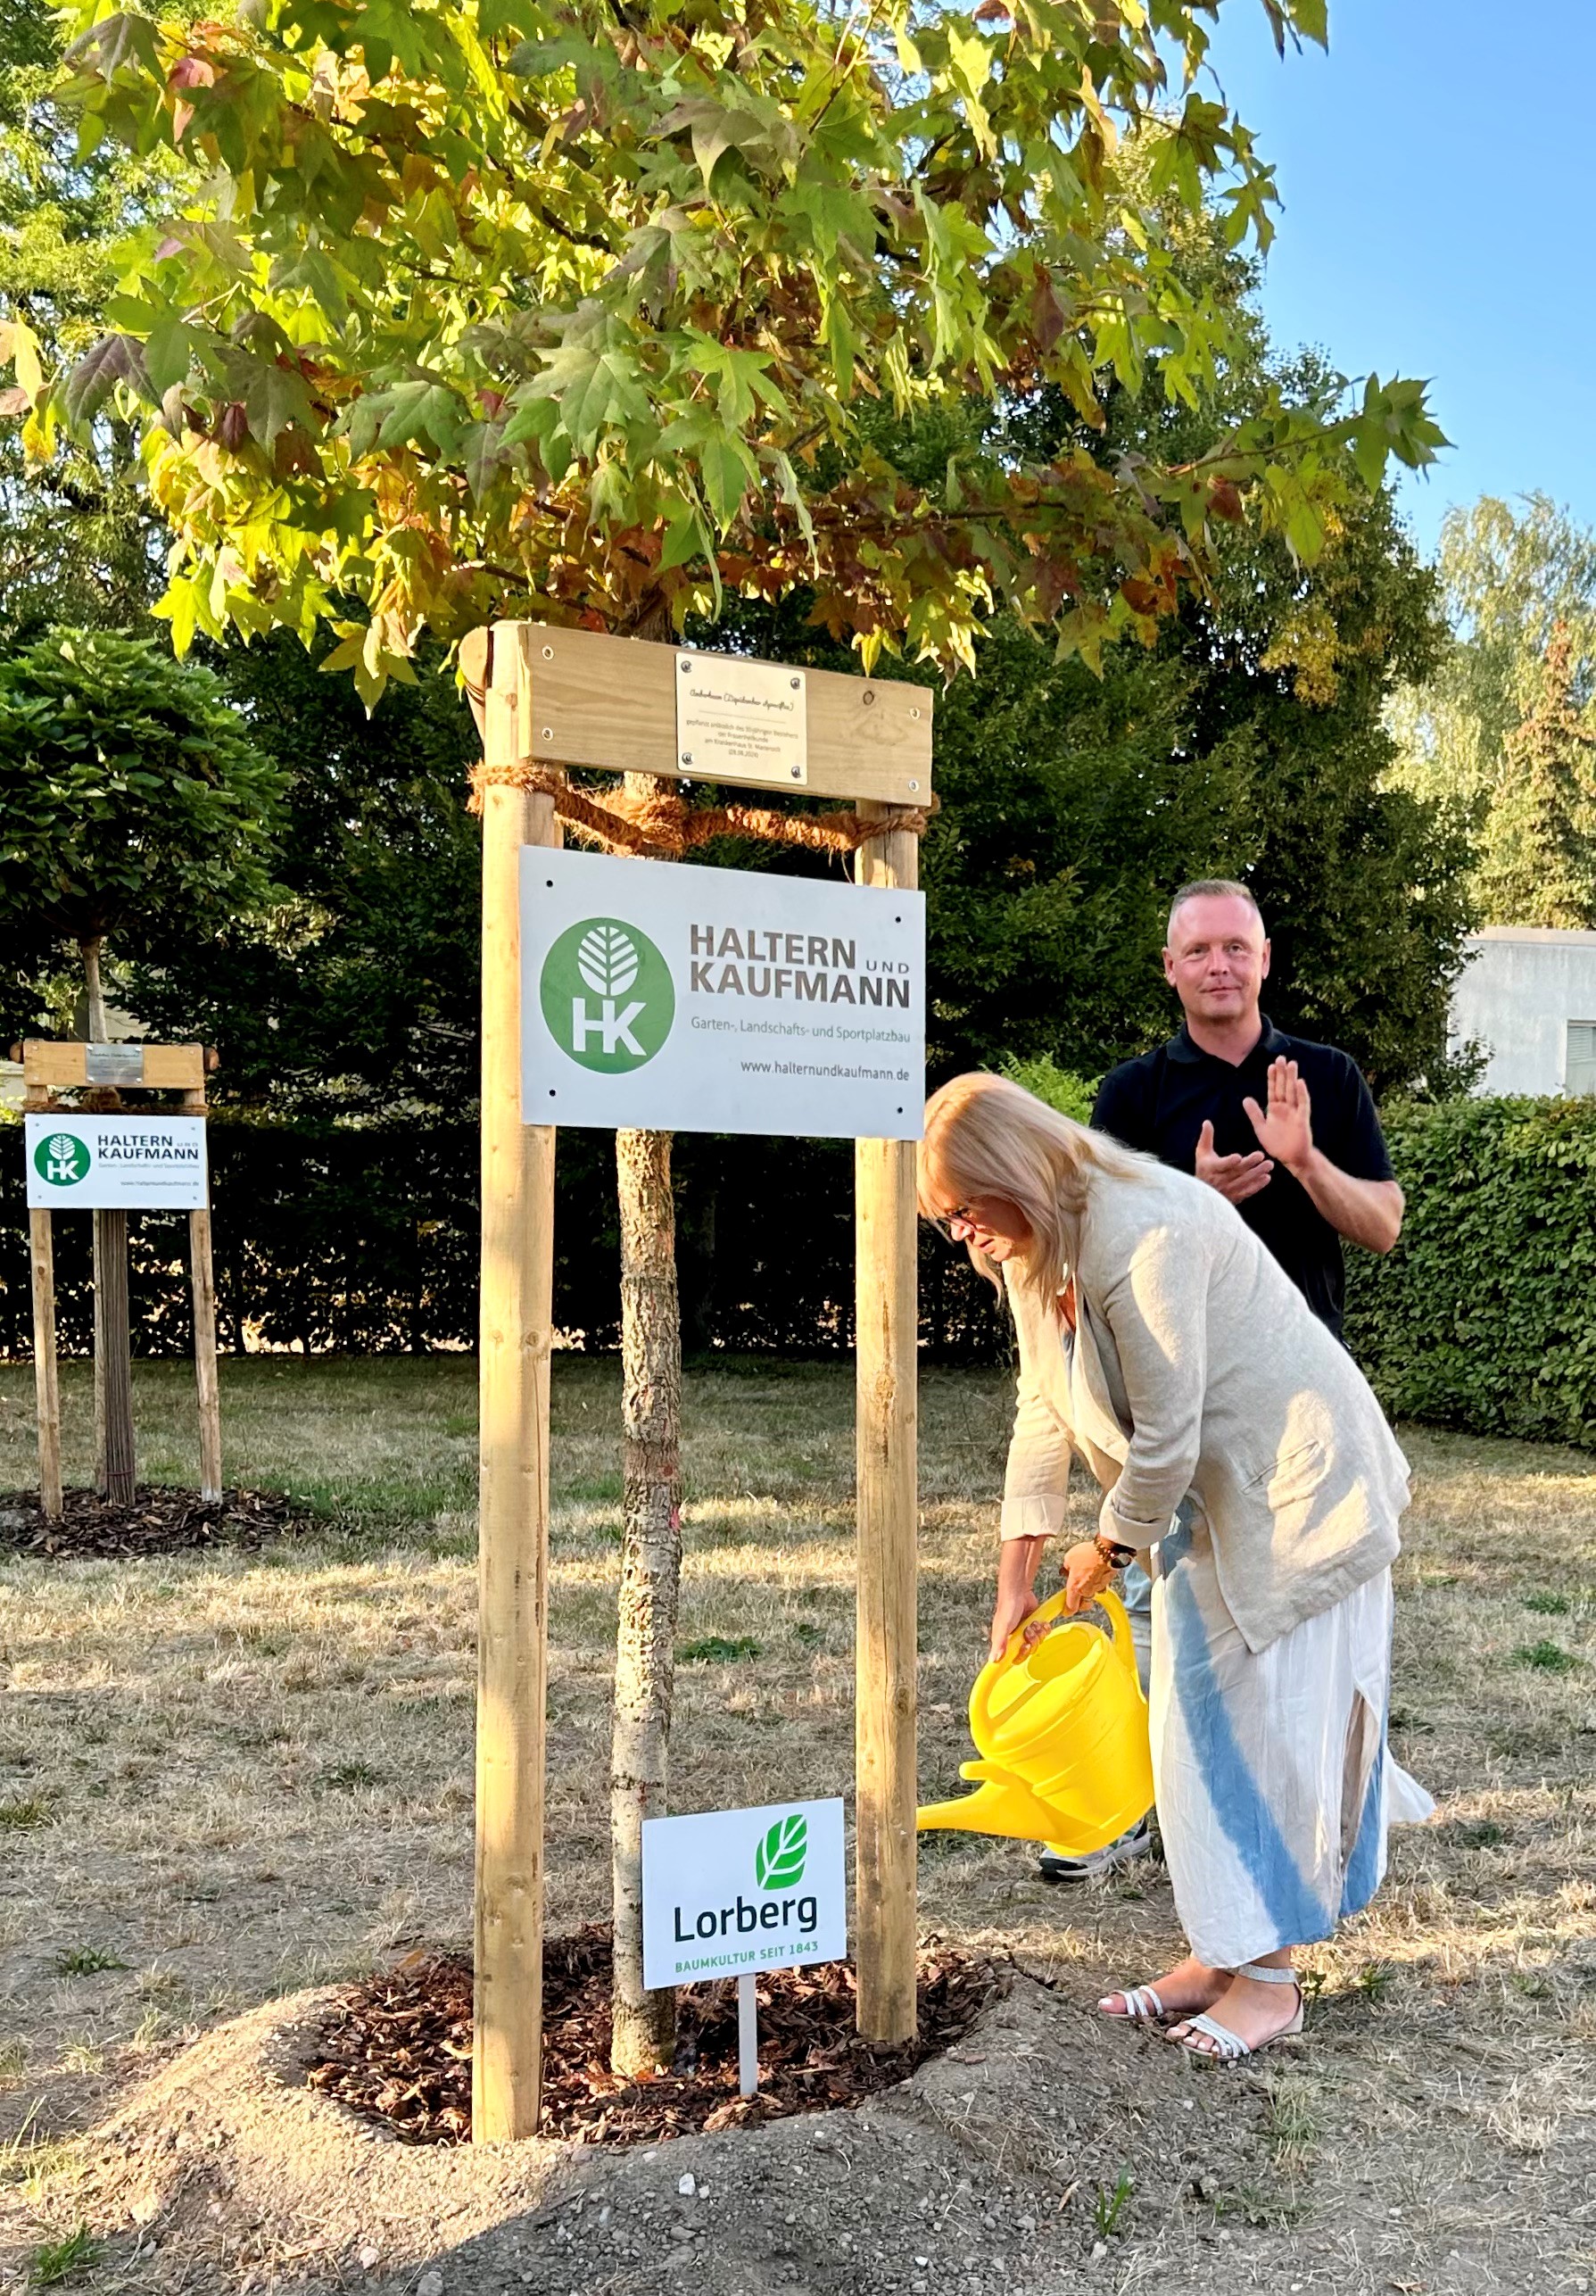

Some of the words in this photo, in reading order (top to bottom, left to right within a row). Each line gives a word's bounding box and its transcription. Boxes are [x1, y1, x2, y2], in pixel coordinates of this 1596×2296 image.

[690, 924, 856, 970] HALTERN
[865, 959, 909, 974] UND
[690, 961, 910, 1009] KAUFMANN
[572, 997, 648, 1057] HK
[690, 1015, 738, 1033] Garten-,
[740, 1020, 809, 1037] Landschafts-
[812, 1025, 834, 1039] und
[836, 1026, 911, 1043] Sportplatzbau
[740, 1060, 910, 1082] www.halternundkaufmann.de
[97, 1134, 173, 1147] HALTERN
[97, 1148, 199, 1160] KAUFMANN
[46, 1160, 80, 1181] HK
[674, 1895, 817, 1943] Lorberg
[674, 1950, 756, 1974] BAUMKULTUR
[759, 1945, 786, 1960] SEIT
[789, 1940, 818, 1955] 1843
